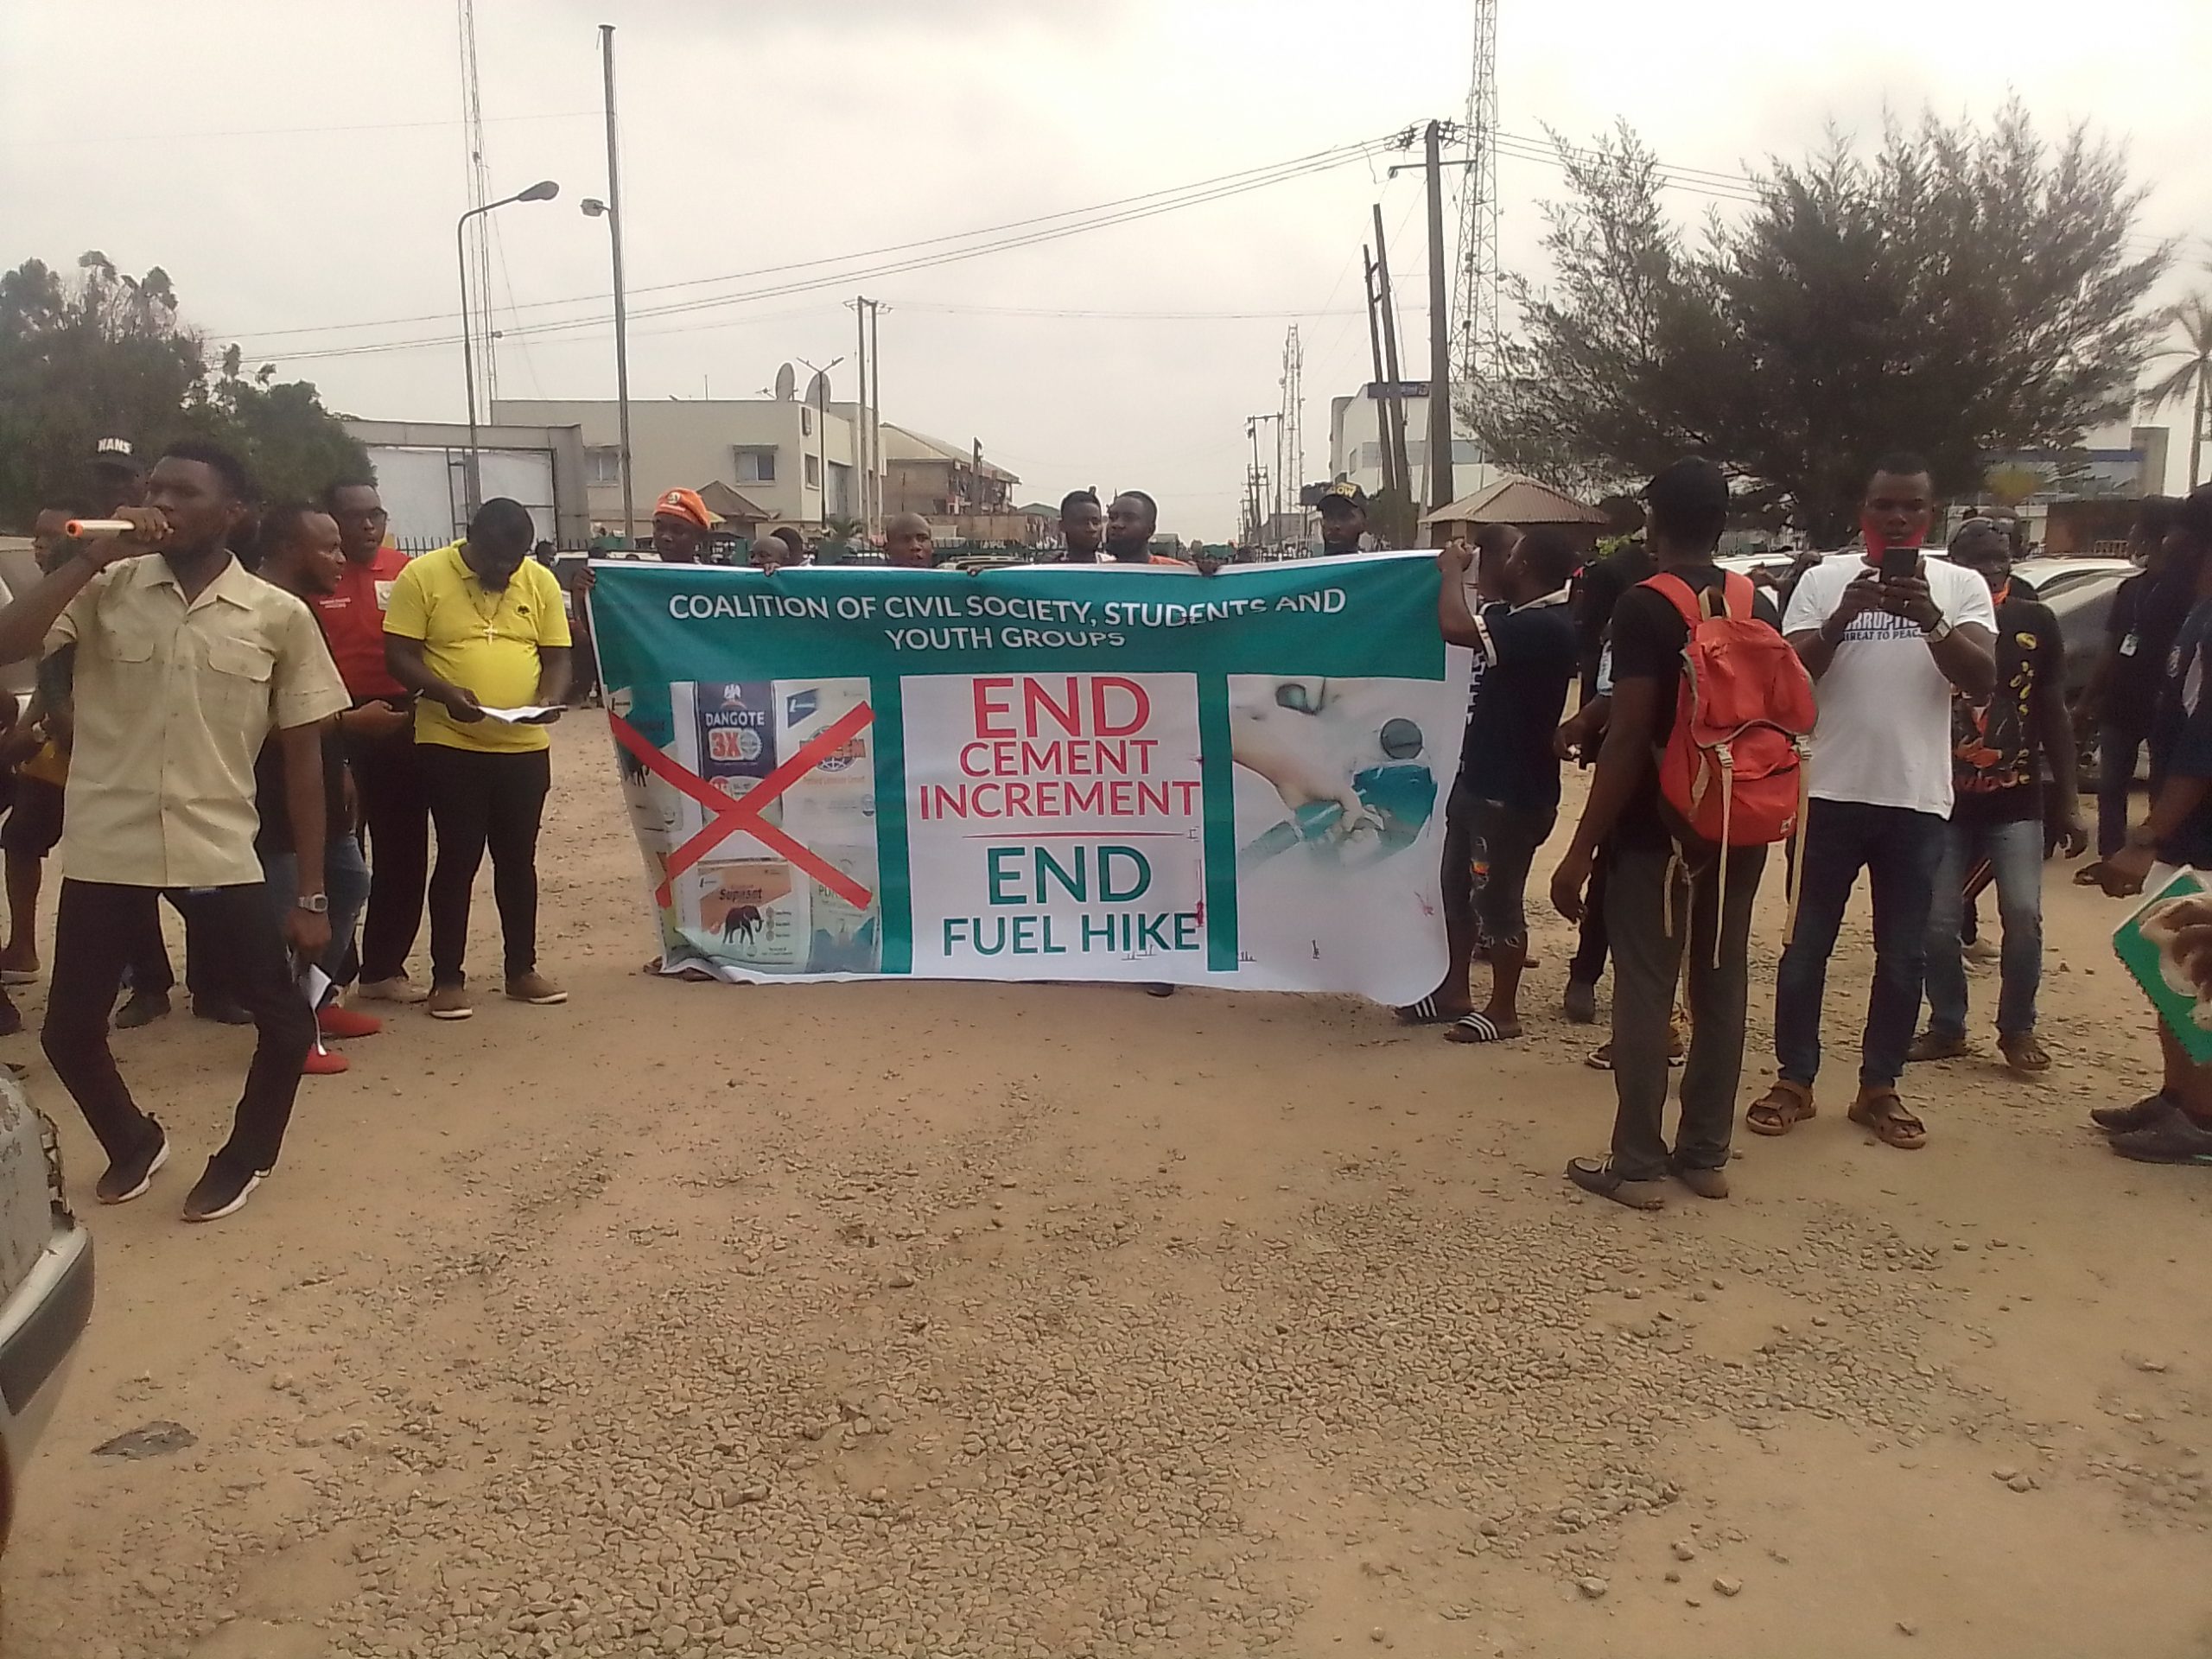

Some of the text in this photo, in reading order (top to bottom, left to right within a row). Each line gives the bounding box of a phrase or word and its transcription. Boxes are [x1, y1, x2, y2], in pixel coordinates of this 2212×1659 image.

[669, 588, 1346, 627] COALITION OF CIVIL SOCIETY, STUDENTS AND
[884, 626, 1126, 650] YOUTH GROUPS
[1878, 631, 1890, 639] TO
[1892, 629, 1920, 639] PEAC
[705, 711, 766, 727] DANGOTE
[973, 676, 1151, 739] END
[710, 730, 742, 758] 3X
[959, 740, 1159, 778] CEMENT
[919, 780, 1202, 820] INCREMENT
[987, 845, 1152, 905] END
[943, 912, 1200, 957] FUEL HIKE
